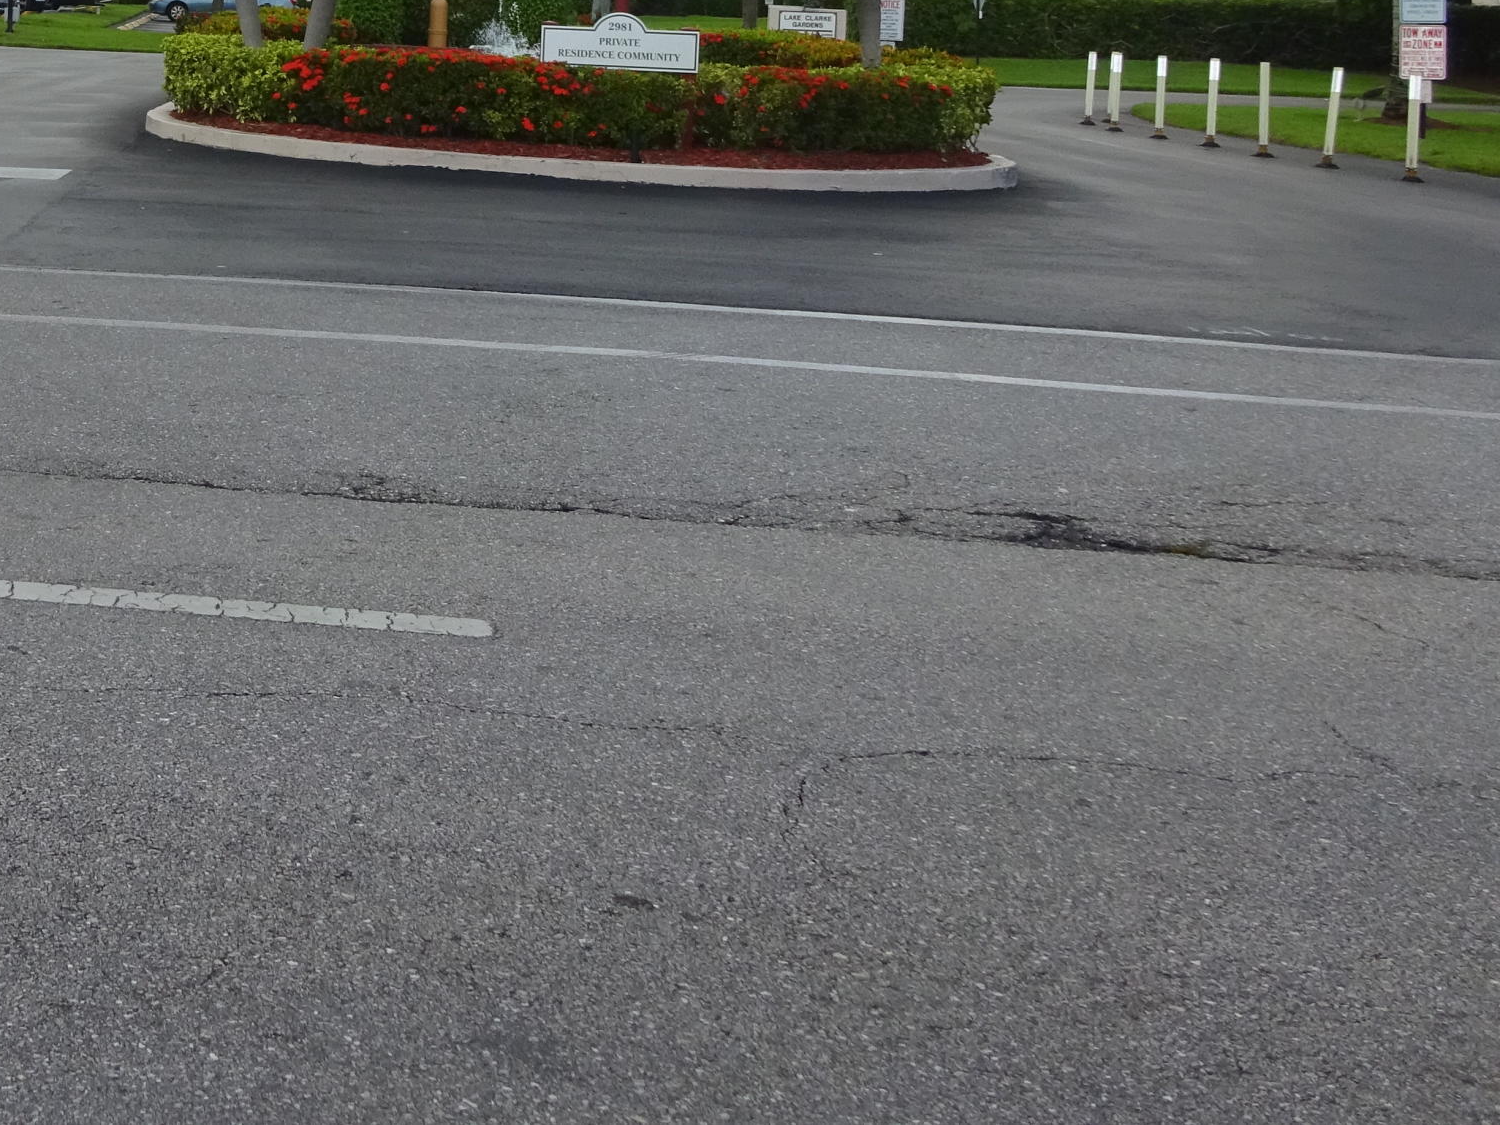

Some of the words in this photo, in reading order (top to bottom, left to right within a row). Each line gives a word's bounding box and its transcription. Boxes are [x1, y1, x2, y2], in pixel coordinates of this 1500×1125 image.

[608, 22, 632, 32] 2981
[599, 37, 641, 47] PRIVATE
[1412, 39, 1433, 49] ZONE
[558, 48, 615, 59] RESIDENCE
[617, 51, 681, 62] COMMUNITY
